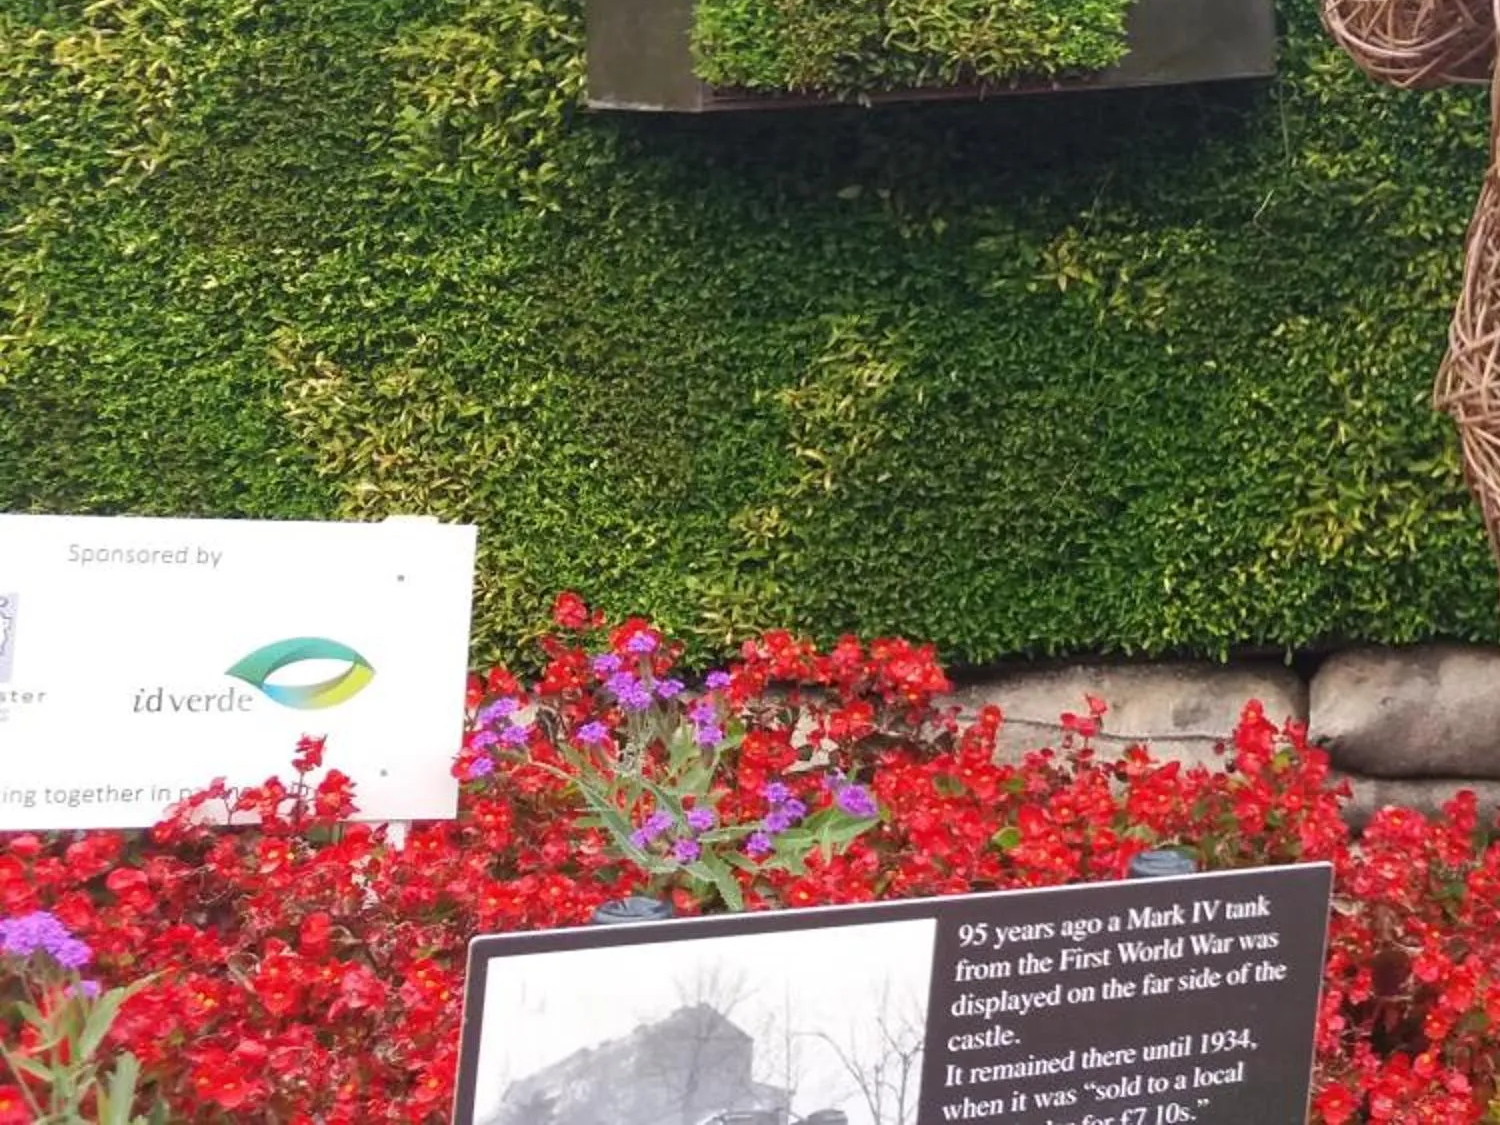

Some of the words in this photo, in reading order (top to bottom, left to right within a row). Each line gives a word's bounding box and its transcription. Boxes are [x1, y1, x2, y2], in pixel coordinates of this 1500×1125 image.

[68, 543, 189, 567] Sponsored
[197, 546, 223, 568] by
[44, 784, 144, 807] together
[151, 784, 171, 801] in
[958, 923, 988, 947] 95
[993, 922, 1056, 950] years
[1060, 916, 1102, 941] ago
[1107, 915, 1121, 932] a
[1126, 903, 1186, 930] Mark
[1192, 899, 1221, 923] IV
[1225, 894, 1272, 920] tank
[955, 958, 1011, 982] from
[1018, 952, 1053, 975] the
[1059, 946, 1112, 971] First
[1117, 936, 1185, 964] World
[1190, 932, 1234, 956] War
[1238, 931, 1280, 950] was
[951, 983, 1062, 1020] displayed
[1067, 985, 1096, 1004] on
[1101, 977, 1137, 1000] the
[1142, 973, 1174, 996] far
[1177, 967, 1221, 991] side
[1226, 962, 1253, 985] of
[1255, 960, 1287, 983] the
[944, 1063, 963, 1087] It
[968, 1050, 1076, 1084] remained
[1081, 1046, 1137, 1070] there
[1143, 1034, 1192, 1062] until
[1199, 1027, 1259, 1055] 1934,
[947, 1024, 1021, 1052] castle.
[942, 1096, 1004, 1121] when
[1011, 1090, 1027, 1112] it
[1034, 1087, 1078, 1108] was
[1083, 1075, 1142, 1101] “sold
[1147, 1075, 1169, 1094] to
[1174, 1073, 1187, 1090] a
[1192, 1060, 1244, 1088] local
